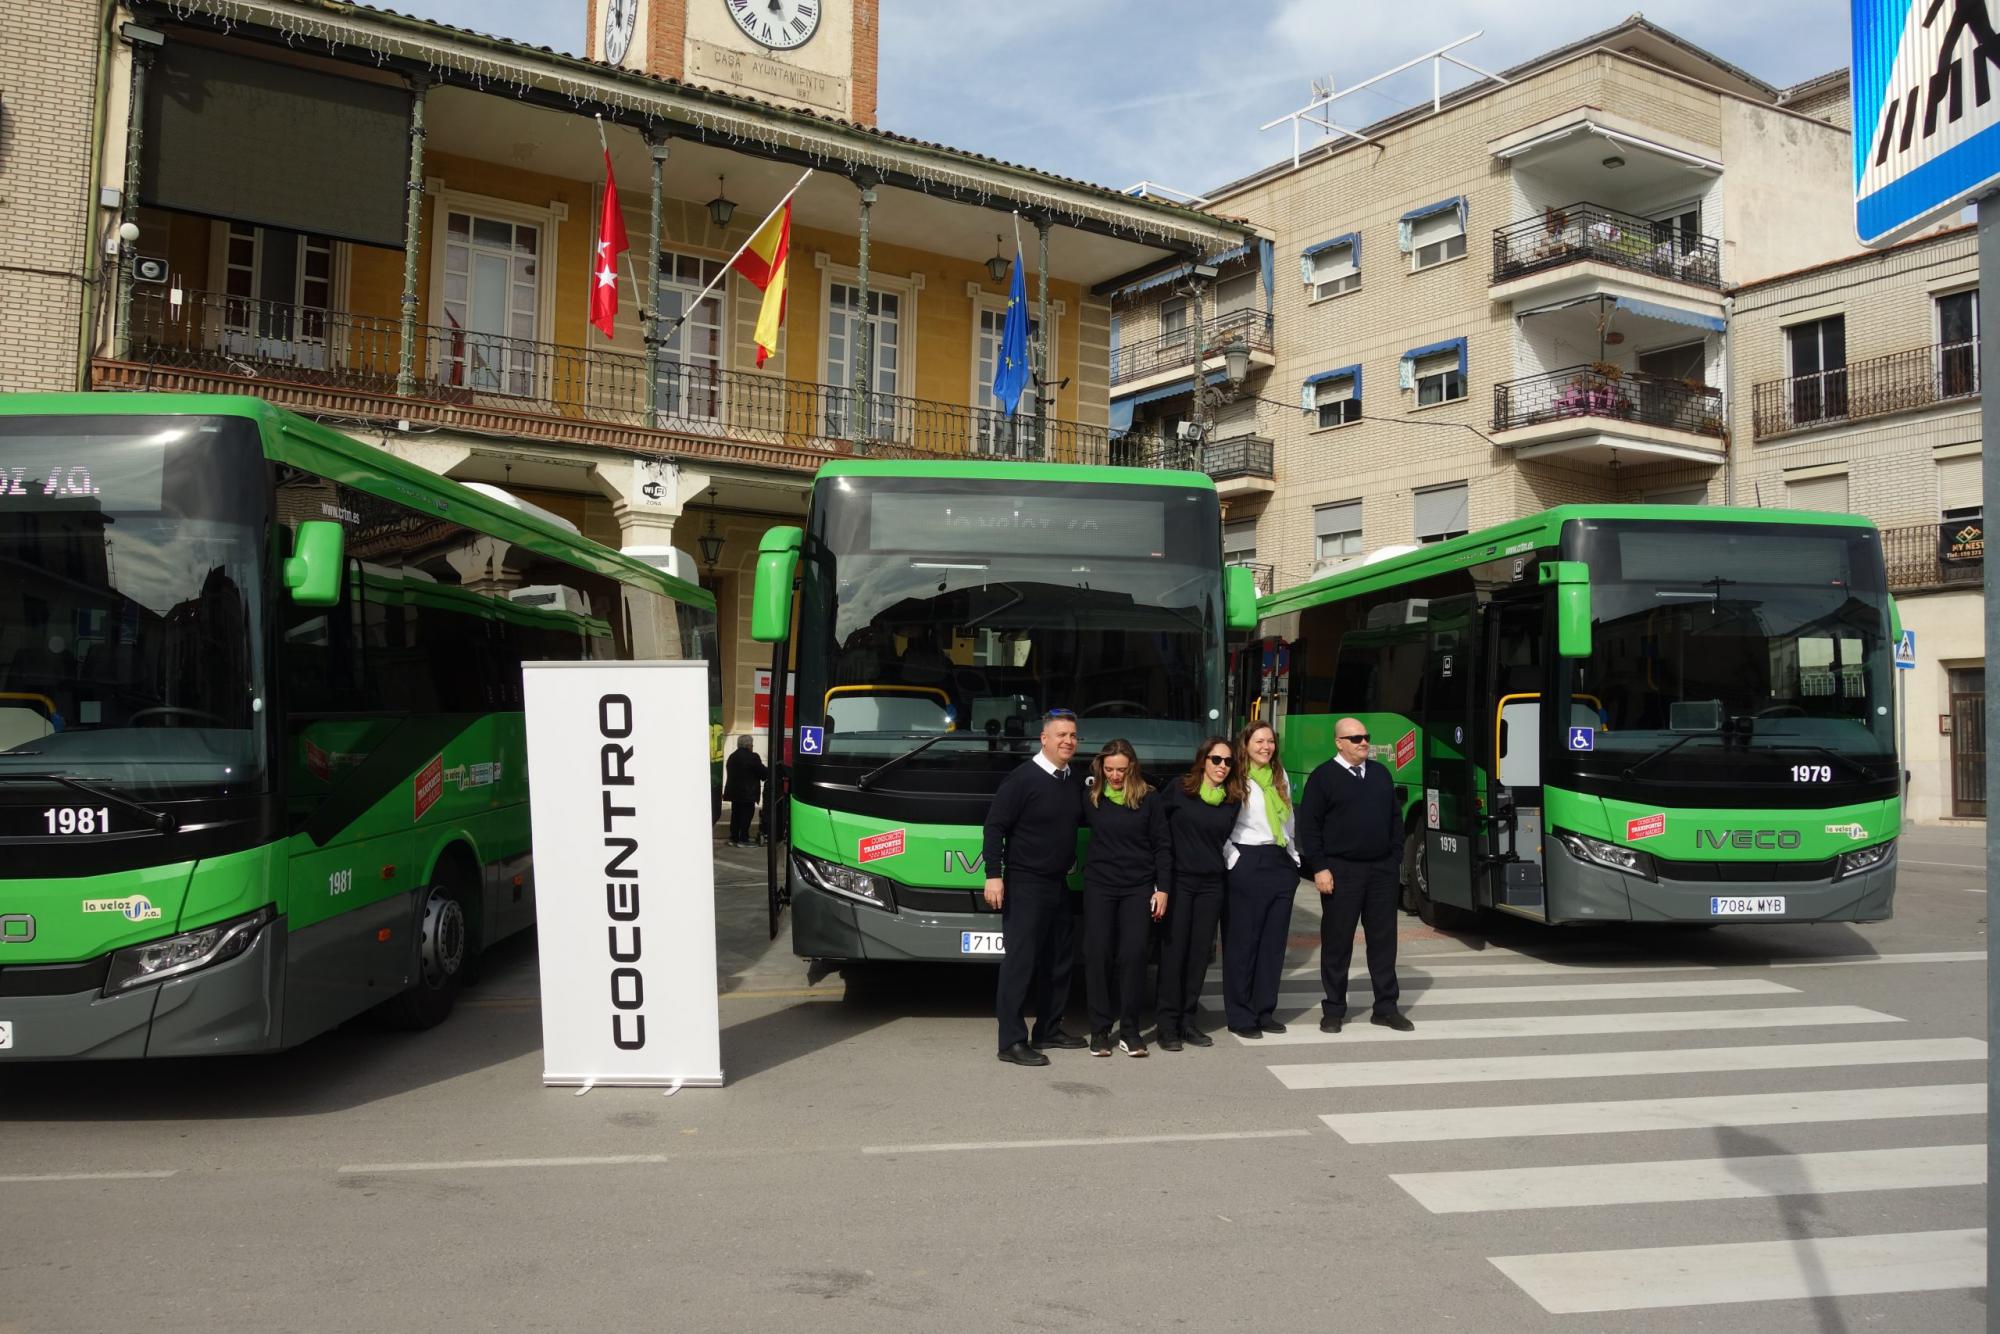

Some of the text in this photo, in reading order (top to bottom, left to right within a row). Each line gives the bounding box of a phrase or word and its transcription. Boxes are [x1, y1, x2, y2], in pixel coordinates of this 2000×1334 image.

[714, 52, 825, 90] CASA AYUNTAMIENTO
[1791, 765, 1832, 782] 1979
[44, 807, 109, 834] 1981
[864, 839, 901, 853] TRANSPORTES
[1440, 836, 1457, 853] 1979
[1696, 830, 1802, 849] IVECO
[880, 846, 902, 857] MADRID
[598, 693, 646, 1051] COCENTRO
[329, 868, 352, 896] 1981
[85, 901, 131, 911] la veloz
[1720, 899, 1782, 913] 7084 MYB
[974, 936, 1004, 951] 710
